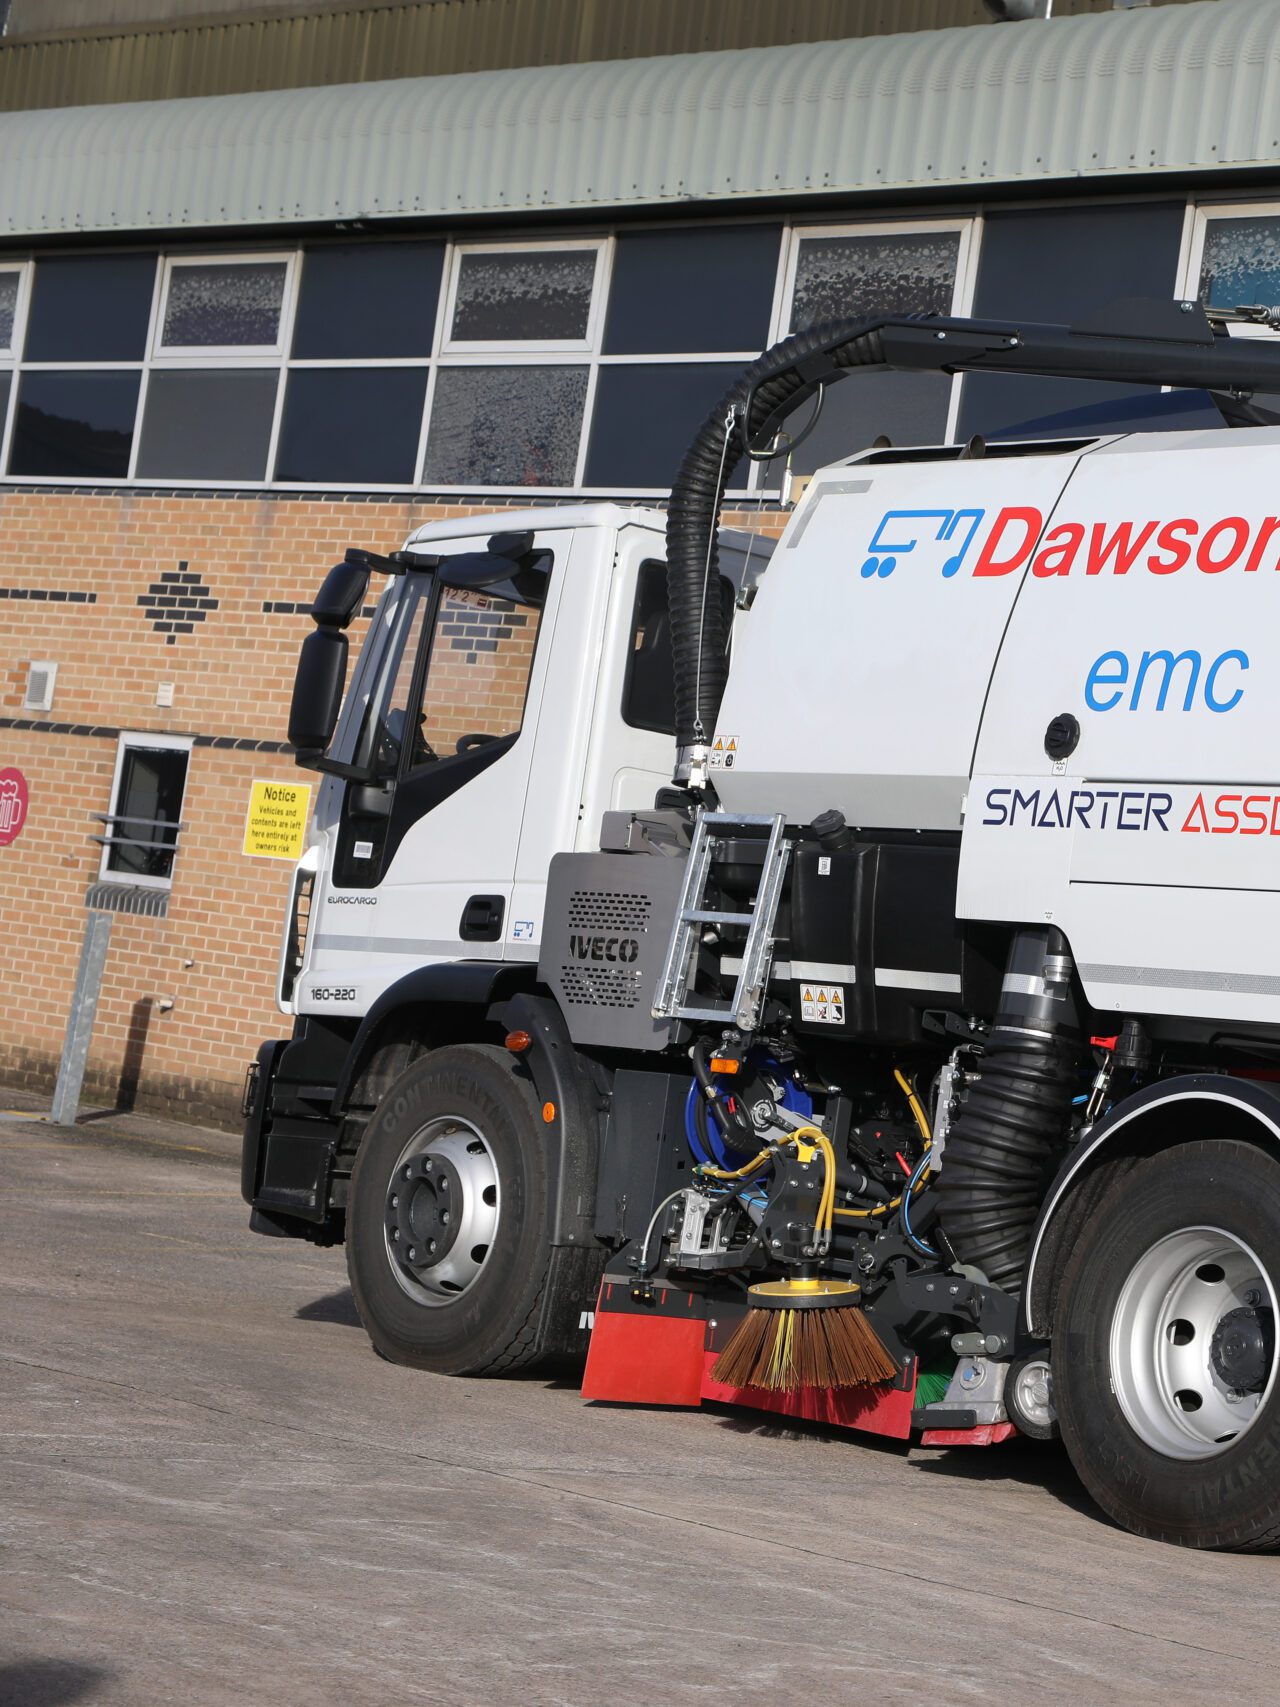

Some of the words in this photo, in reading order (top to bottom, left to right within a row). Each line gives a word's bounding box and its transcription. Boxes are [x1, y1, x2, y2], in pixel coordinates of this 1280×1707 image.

[1085, 649, 1250, 713] emc
[263, 786, 297, 803] Notice
[259, 805, 284, 816] Vehicles
[285, 808, 297, 817] and
[983, 788, 1173, 832] SMARTER
[251, 818, 277, 828] contents
[278, 821, 289, 829] are
[290, 820, 302, 830] left
[251, 829, 265, 839] here
[266, 831, 289, 842] entirely
[290, 834, 297, 842] at
[255, 843, 277, 852] owners
[278, 843, 290, 853] risk
[327, 896, 378, 906] EUROCARGO
[569, 935, 639, 963] IVECO
[311, 988, 356, 1001] 160-220
